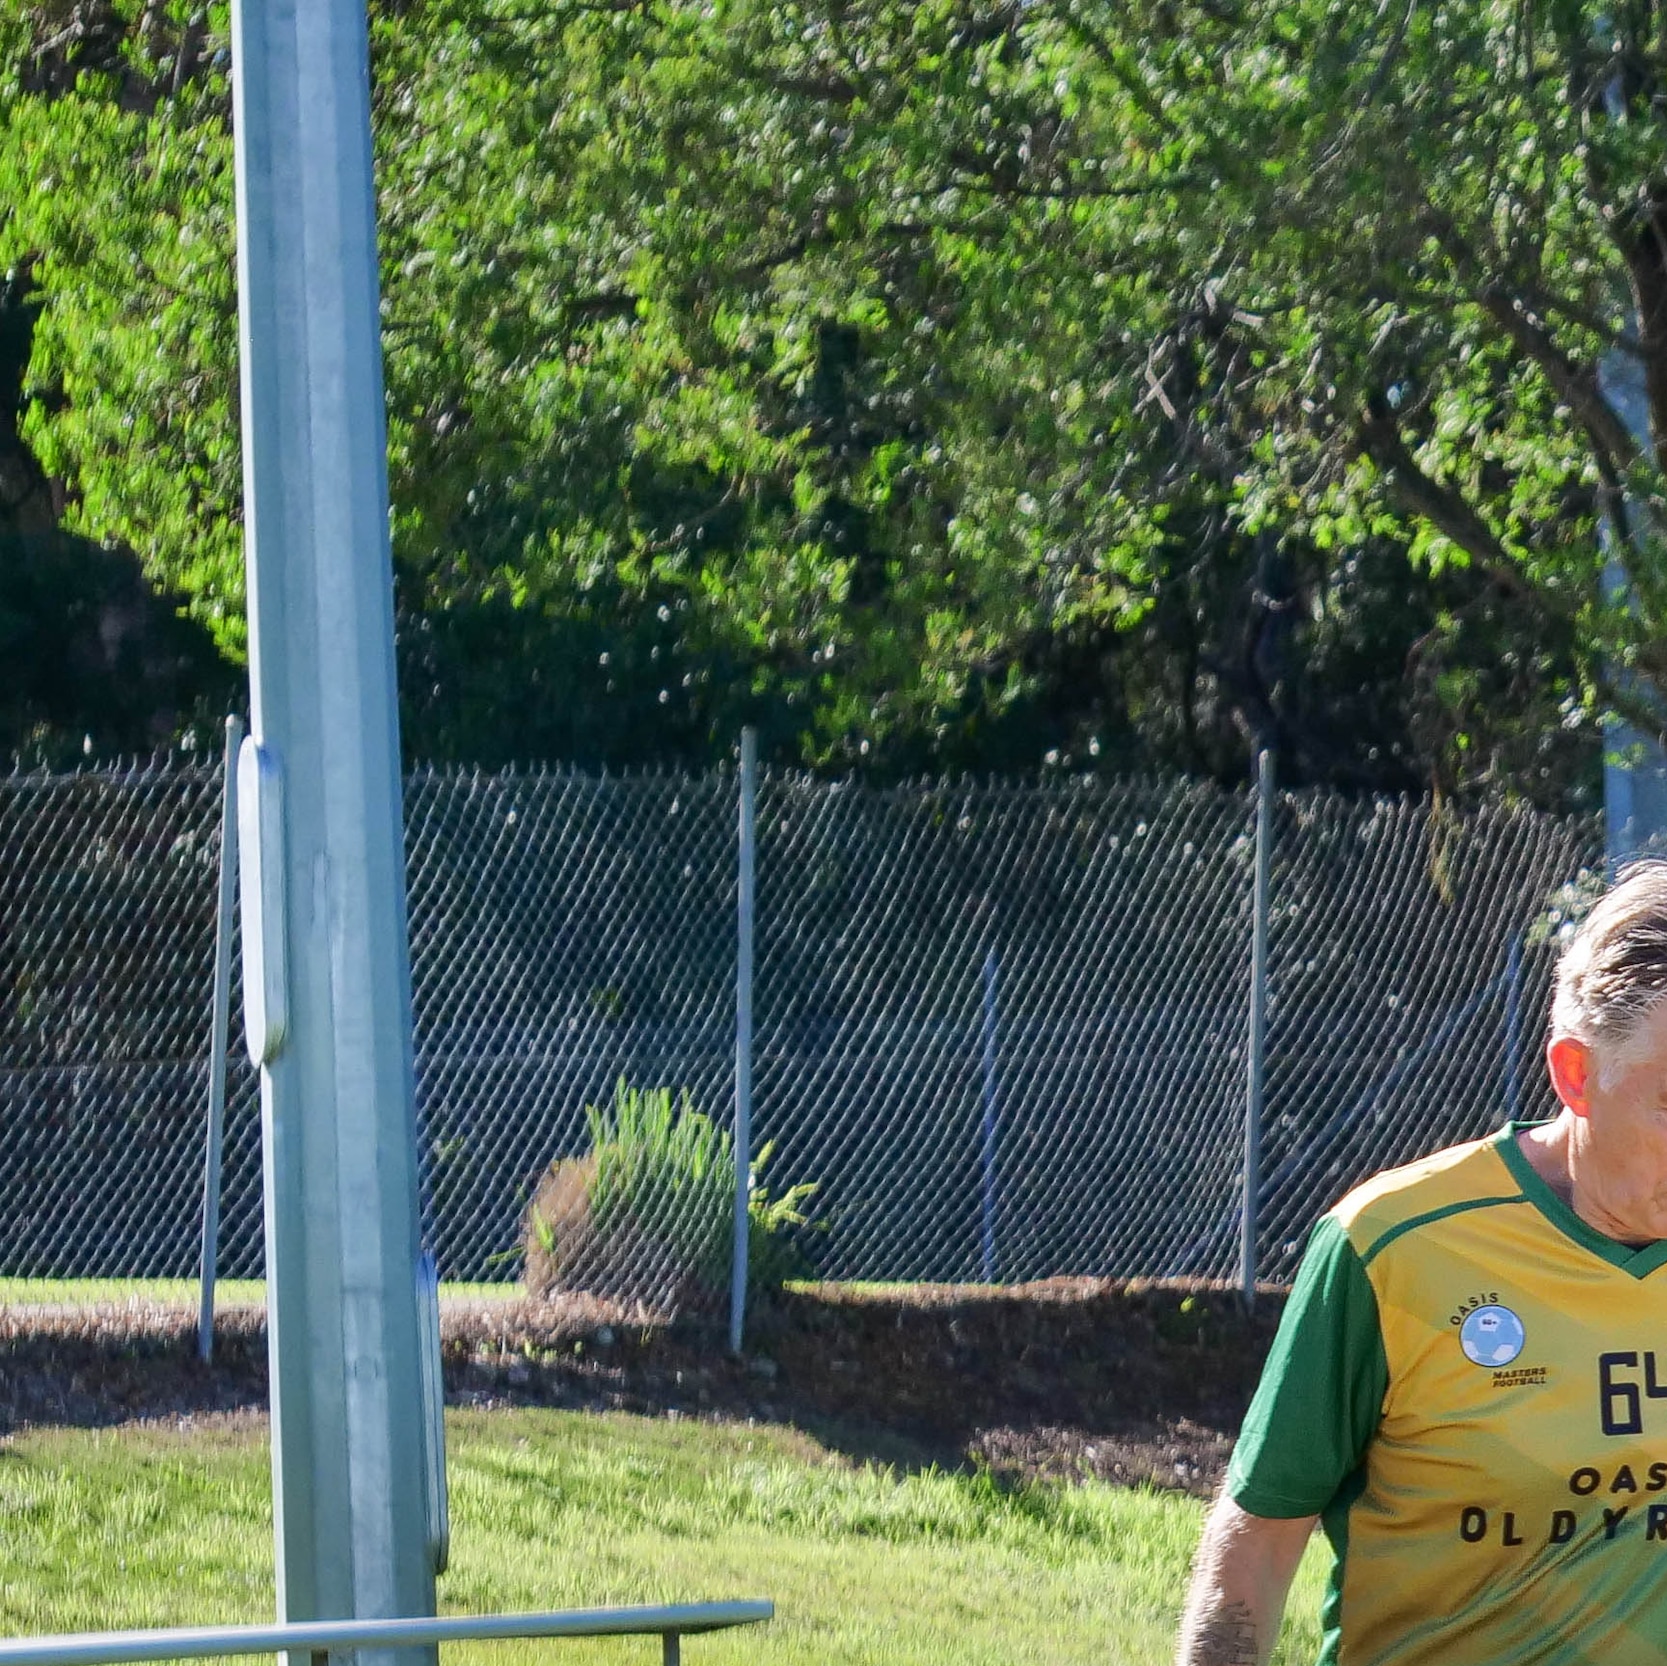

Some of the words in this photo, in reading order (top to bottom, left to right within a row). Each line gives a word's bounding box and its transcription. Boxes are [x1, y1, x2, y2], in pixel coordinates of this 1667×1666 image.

[1450, 1292, 1498, 1325] OASIS
[1493, 1367, 1546, 1379] MASTERS
[1493, 1377, 1546, 1387] FOOTBALL
